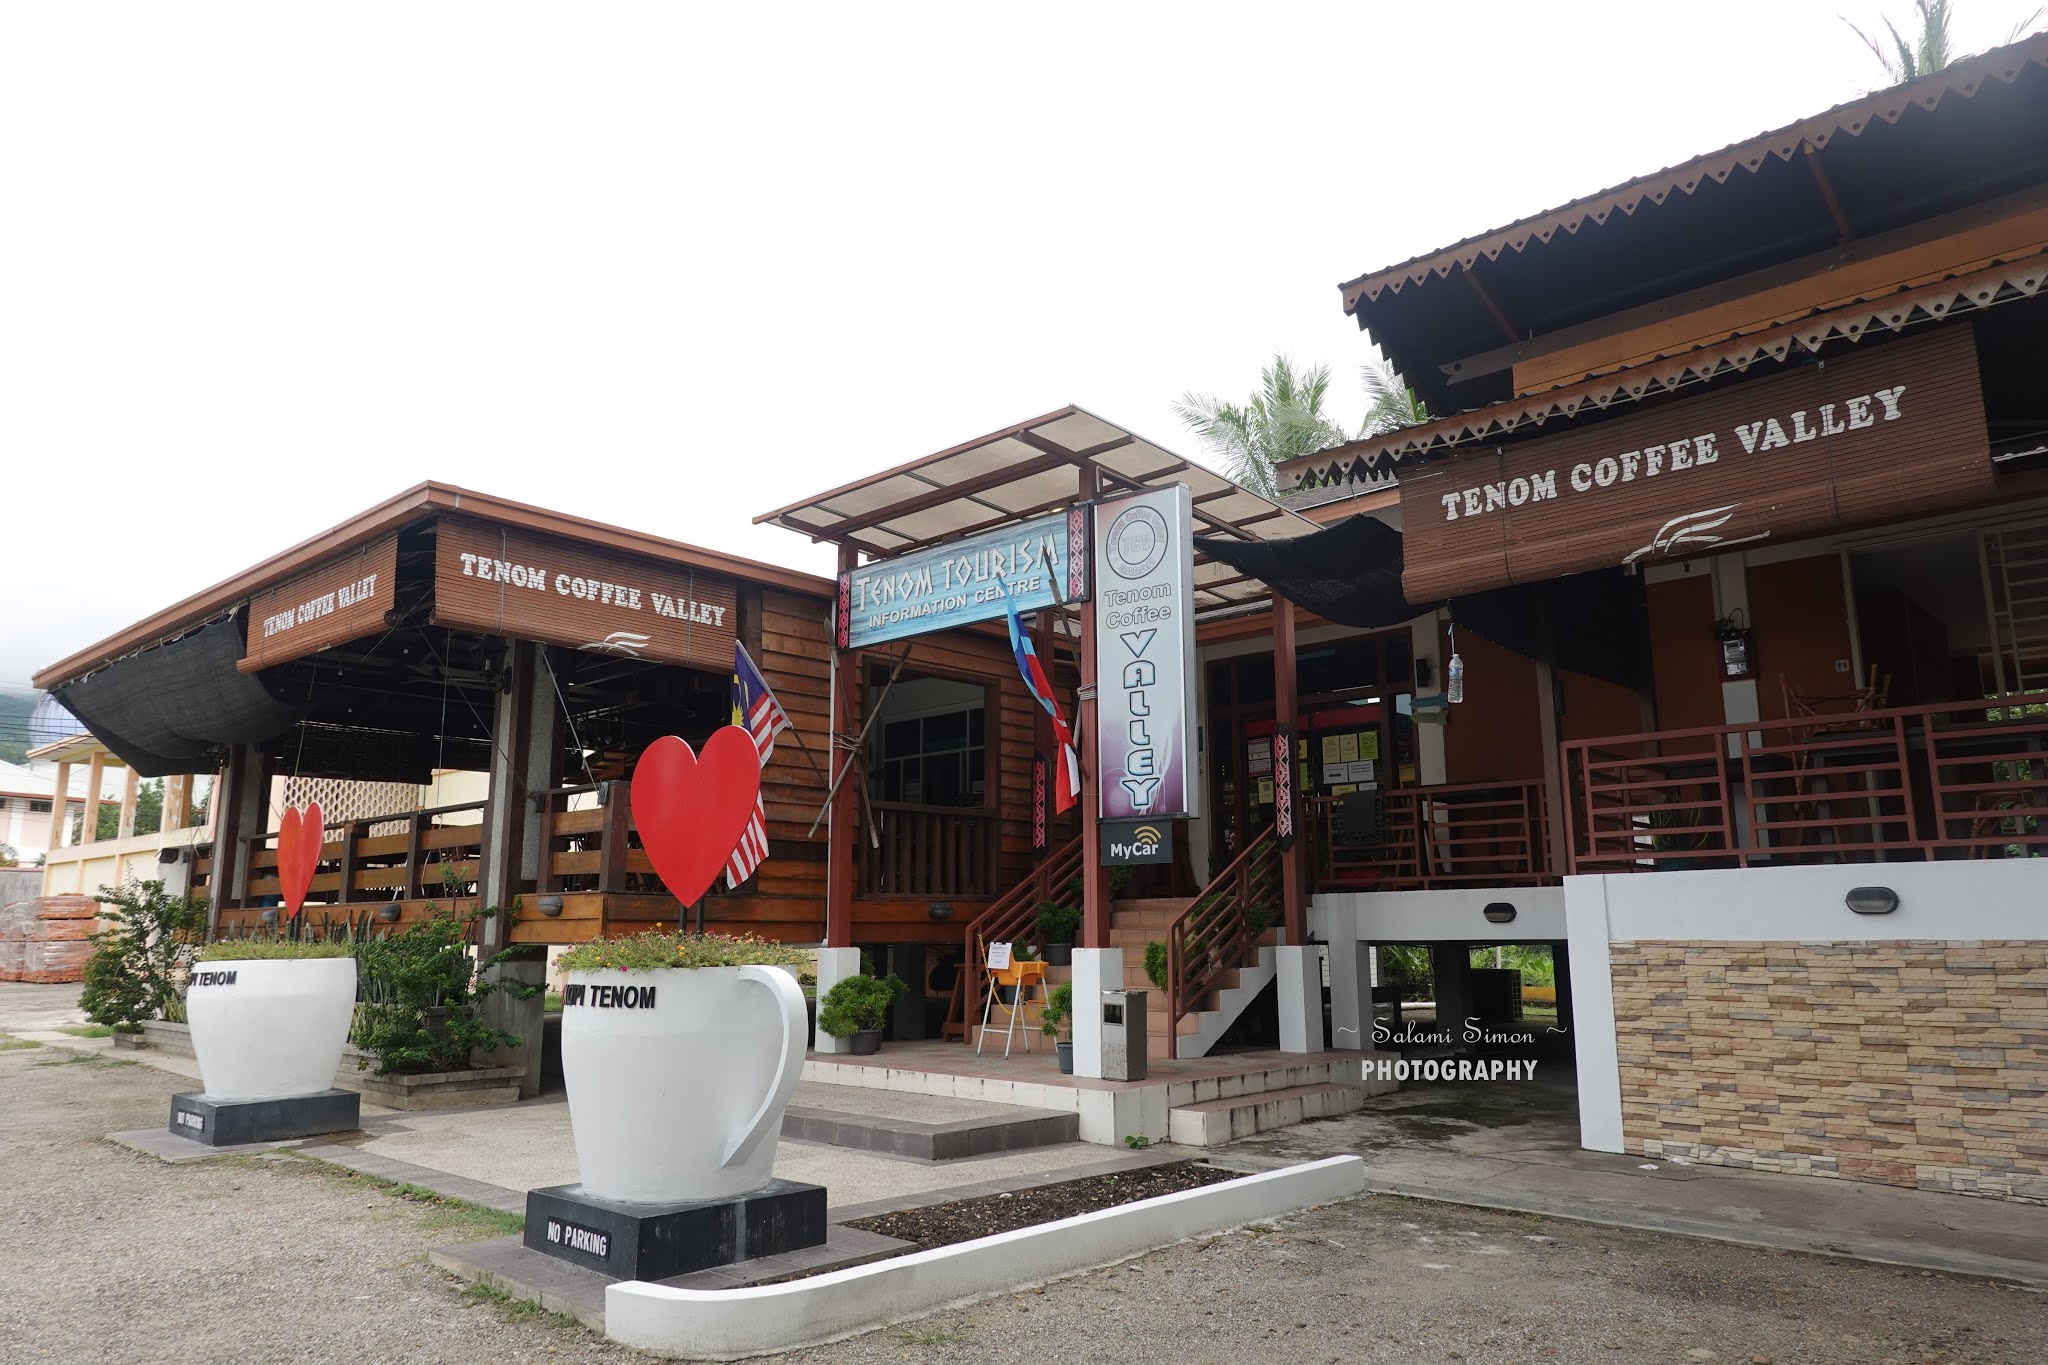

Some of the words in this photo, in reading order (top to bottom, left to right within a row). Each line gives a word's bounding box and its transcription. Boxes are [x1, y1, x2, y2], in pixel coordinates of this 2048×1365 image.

[1441, 469, 1558, 521] TENOM
[1570, 432, 1719, 493] COFFEE
[1734, 385, 1906, 456] VALLEY
[459, 552, 547, 591] TENOM
[555, 573, 642, 610] COFFEE
[650, 592, 726, 627] VALLEY
[856, 565, 934, 612] TENOM
[942, 533, 1060, 590] TOURISM
[263, 607, 296, 638] TENOM
[297, 592, 335, 625] COFFEE
[337, 573, 378, 609] VALLEY
[869, 593, 968, 628] INFORMATION
[974, 576, 1041, 604] CENTRE
[1104, 582, 1172, 608] Tenom
[1106, 606, 1172, 629] Coffee
[1119, 628, 1161, 807] VALLEY
[1110, 841, 1159, 860] MyCar
[199, 971, 238, 986] TENOM
[591, 985, 657, 1009] TENOM
[547, 1221, 561, 1244] NO
[564, 1225, 607, 1257] PARKING
